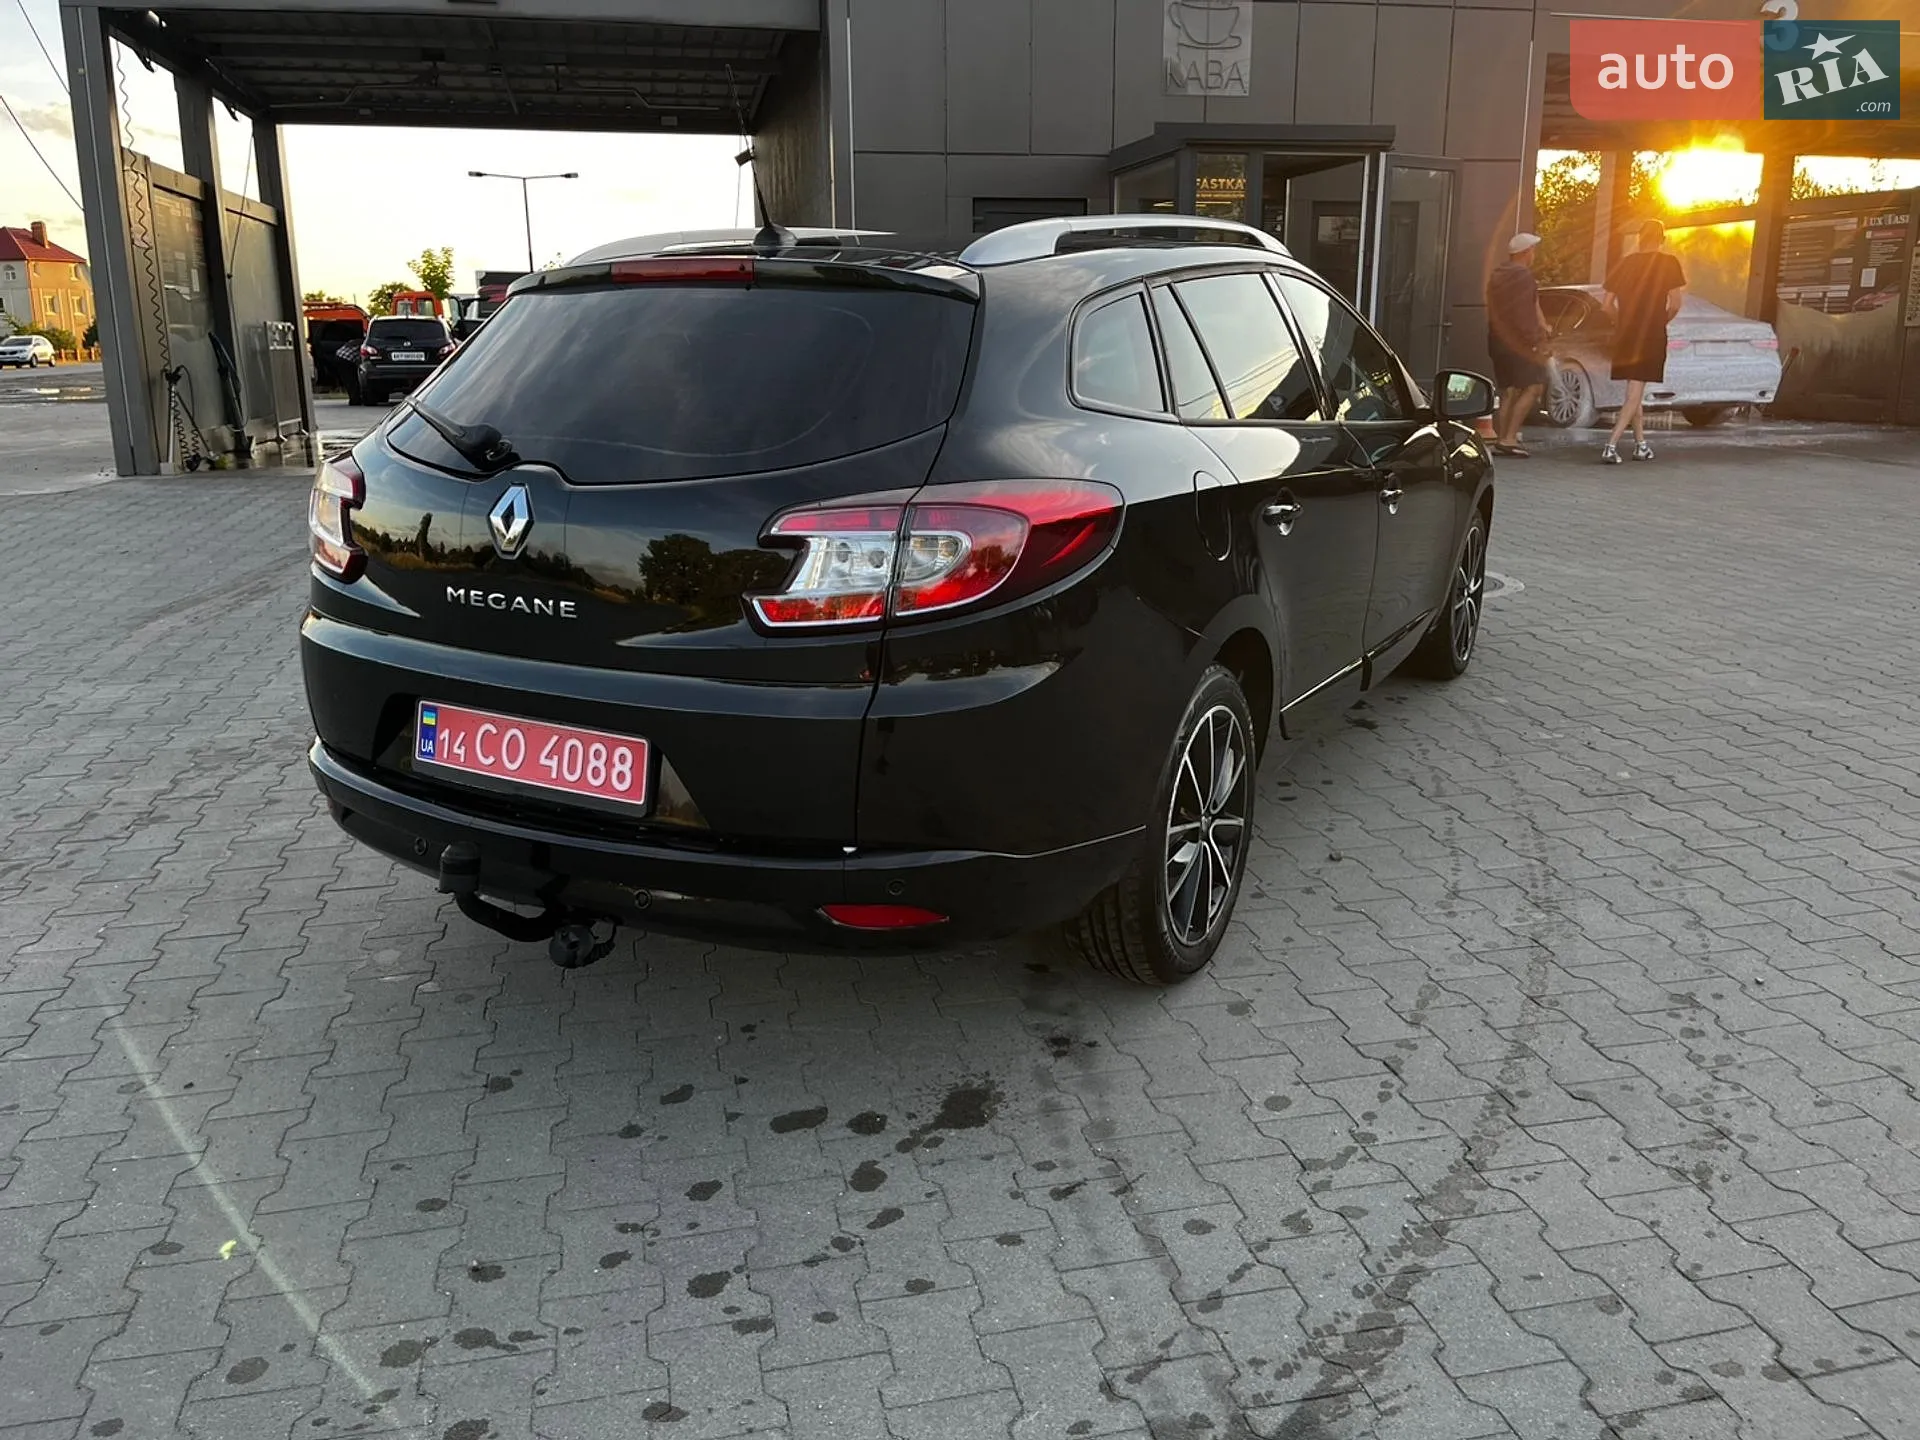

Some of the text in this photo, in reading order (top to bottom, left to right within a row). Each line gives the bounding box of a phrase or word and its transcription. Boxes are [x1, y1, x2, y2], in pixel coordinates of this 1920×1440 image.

[1759, 0, 1799, 51] 3
[446, 586, 578, 619] MEGANE
[421, 738, 434, 754] UA
[539, 735, 634, 792] 4088
